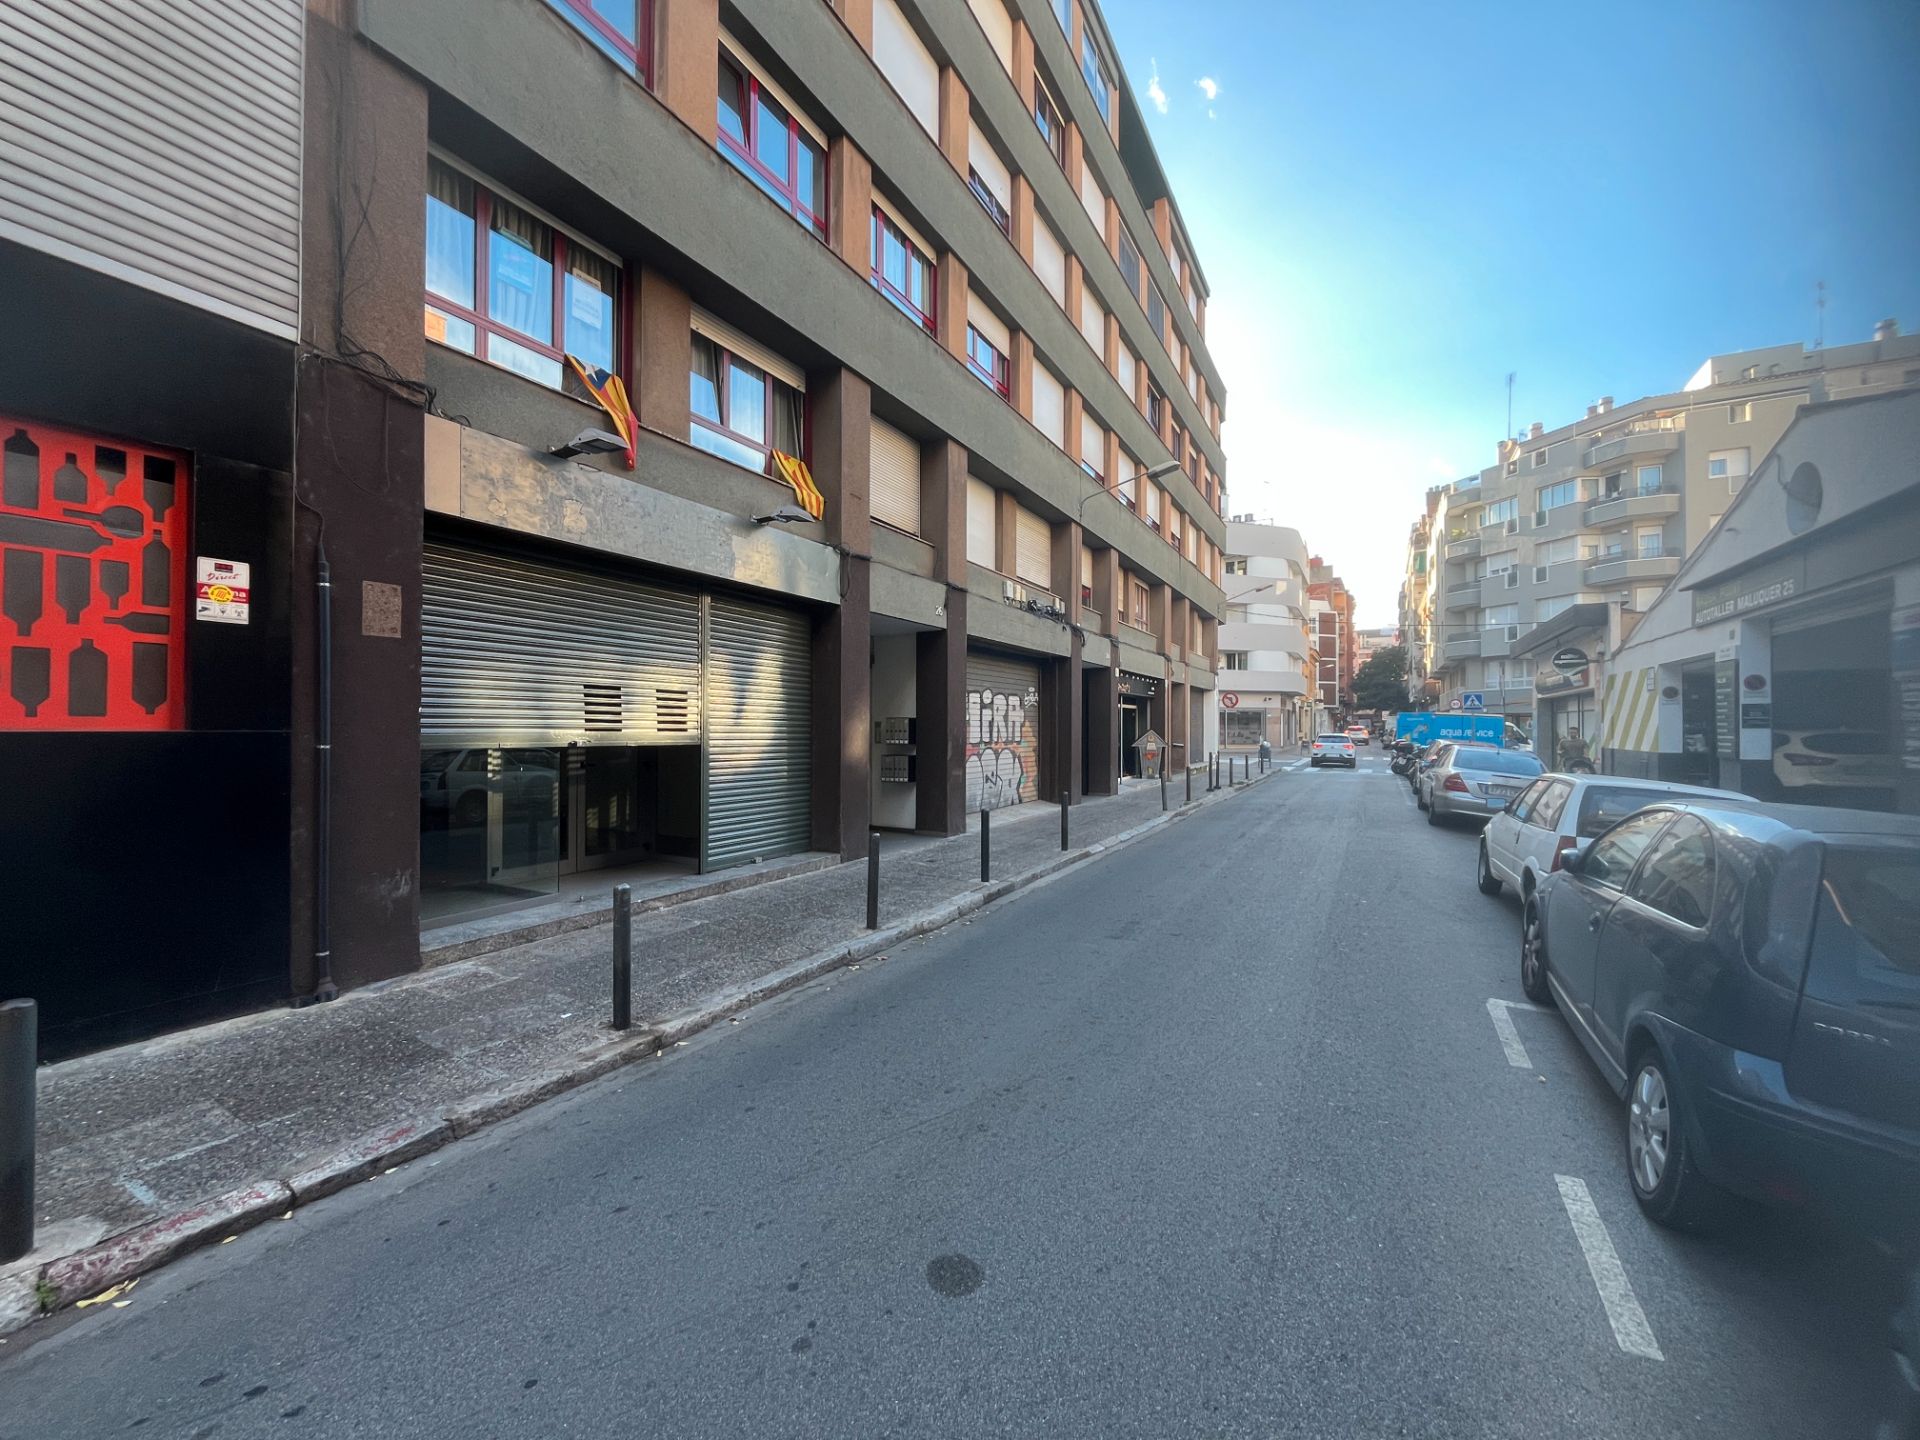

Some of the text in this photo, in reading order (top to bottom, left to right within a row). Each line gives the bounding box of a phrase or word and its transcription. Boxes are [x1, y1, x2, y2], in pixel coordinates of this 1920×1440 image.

[1695, 600, 1735, 626] AUTOTALLER
[1737, 583, 1782, 611] MALUQUER
[1783, 579, 1794, 597] 25
[1440, 728, 1494, 738] aquasevice
